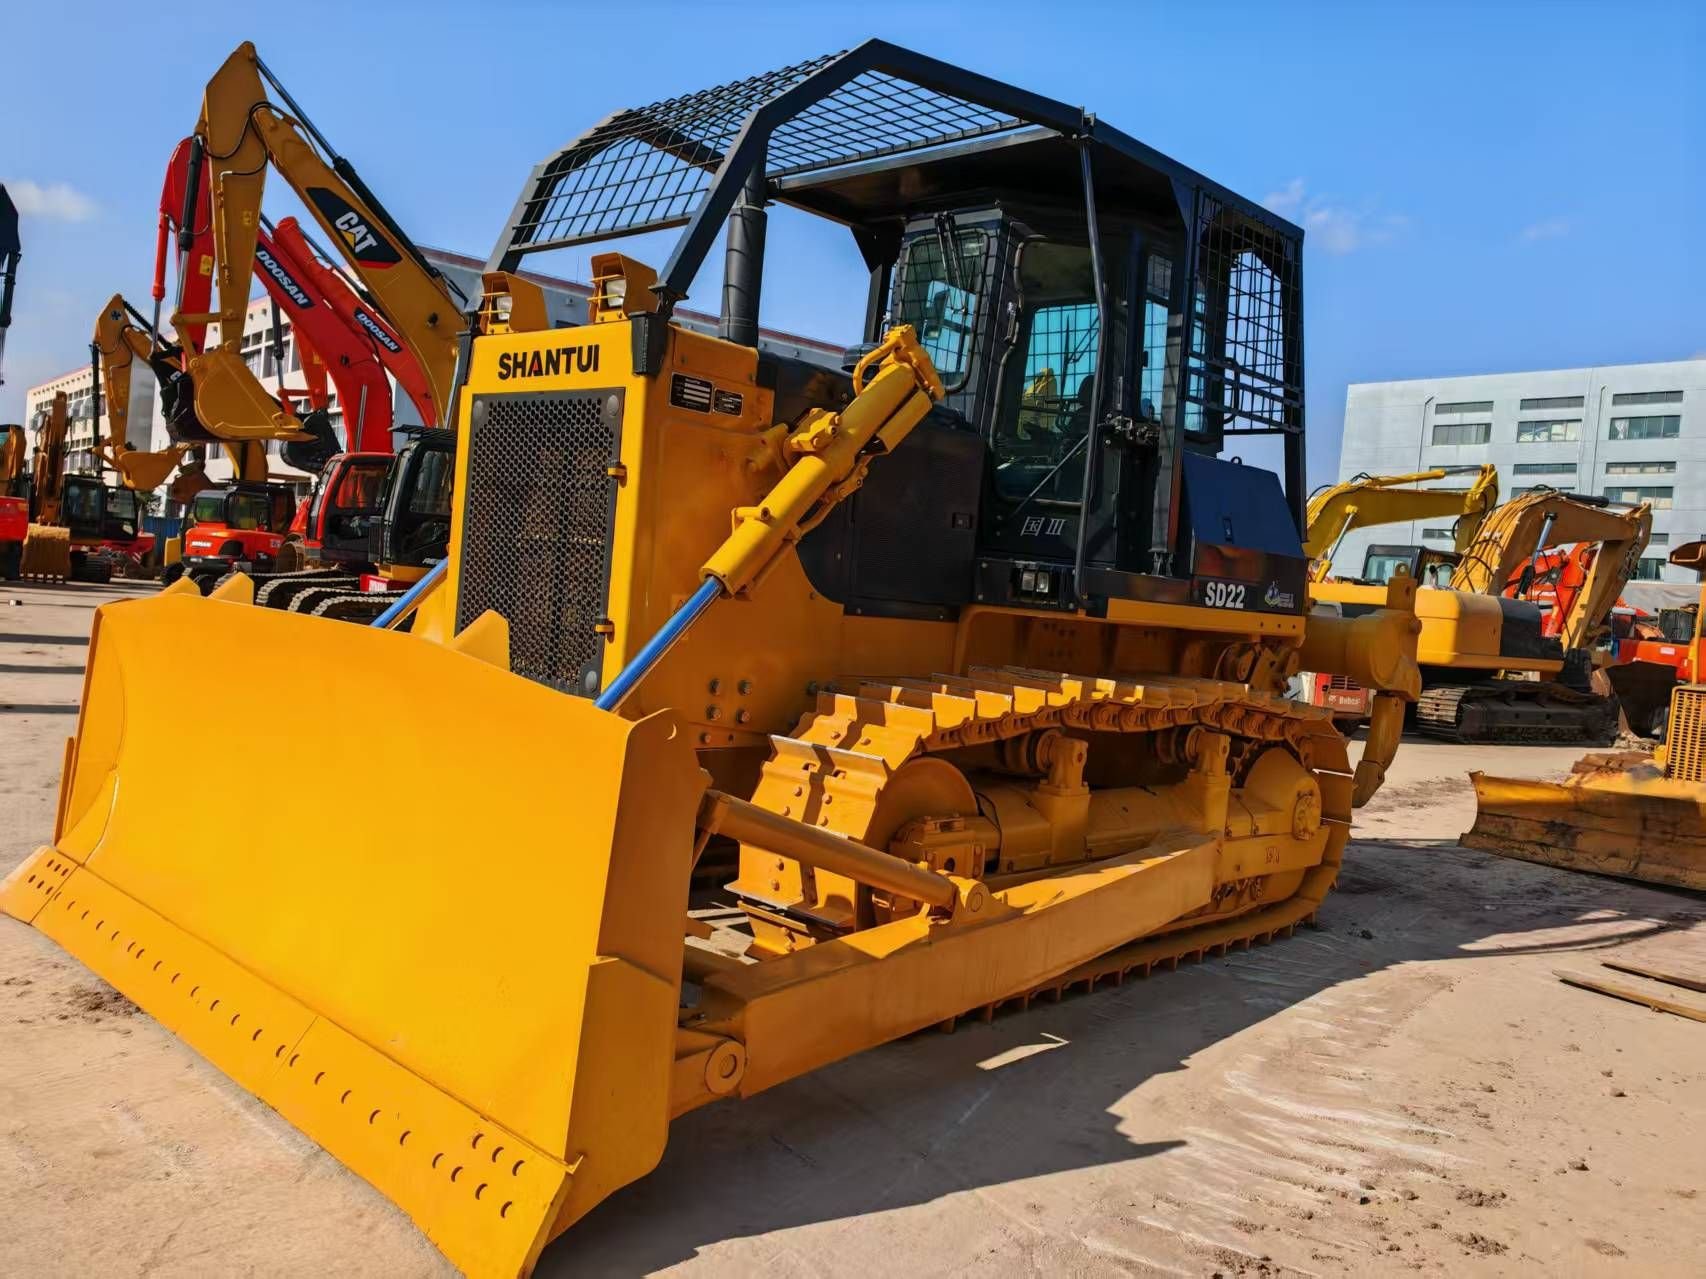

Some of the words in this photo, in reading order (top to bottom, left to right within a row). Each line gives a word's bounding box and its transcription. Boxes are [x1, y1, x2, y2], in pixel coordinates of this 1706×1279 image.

[335, 211, 378, 253] CAT
[256, 250, 308, 305] DOOSAN
[357, 313, 398, 350] DOOSAN
[498, 344, 600, 380] SHANTUI
[1205, 581, 1245, 608] SD22
